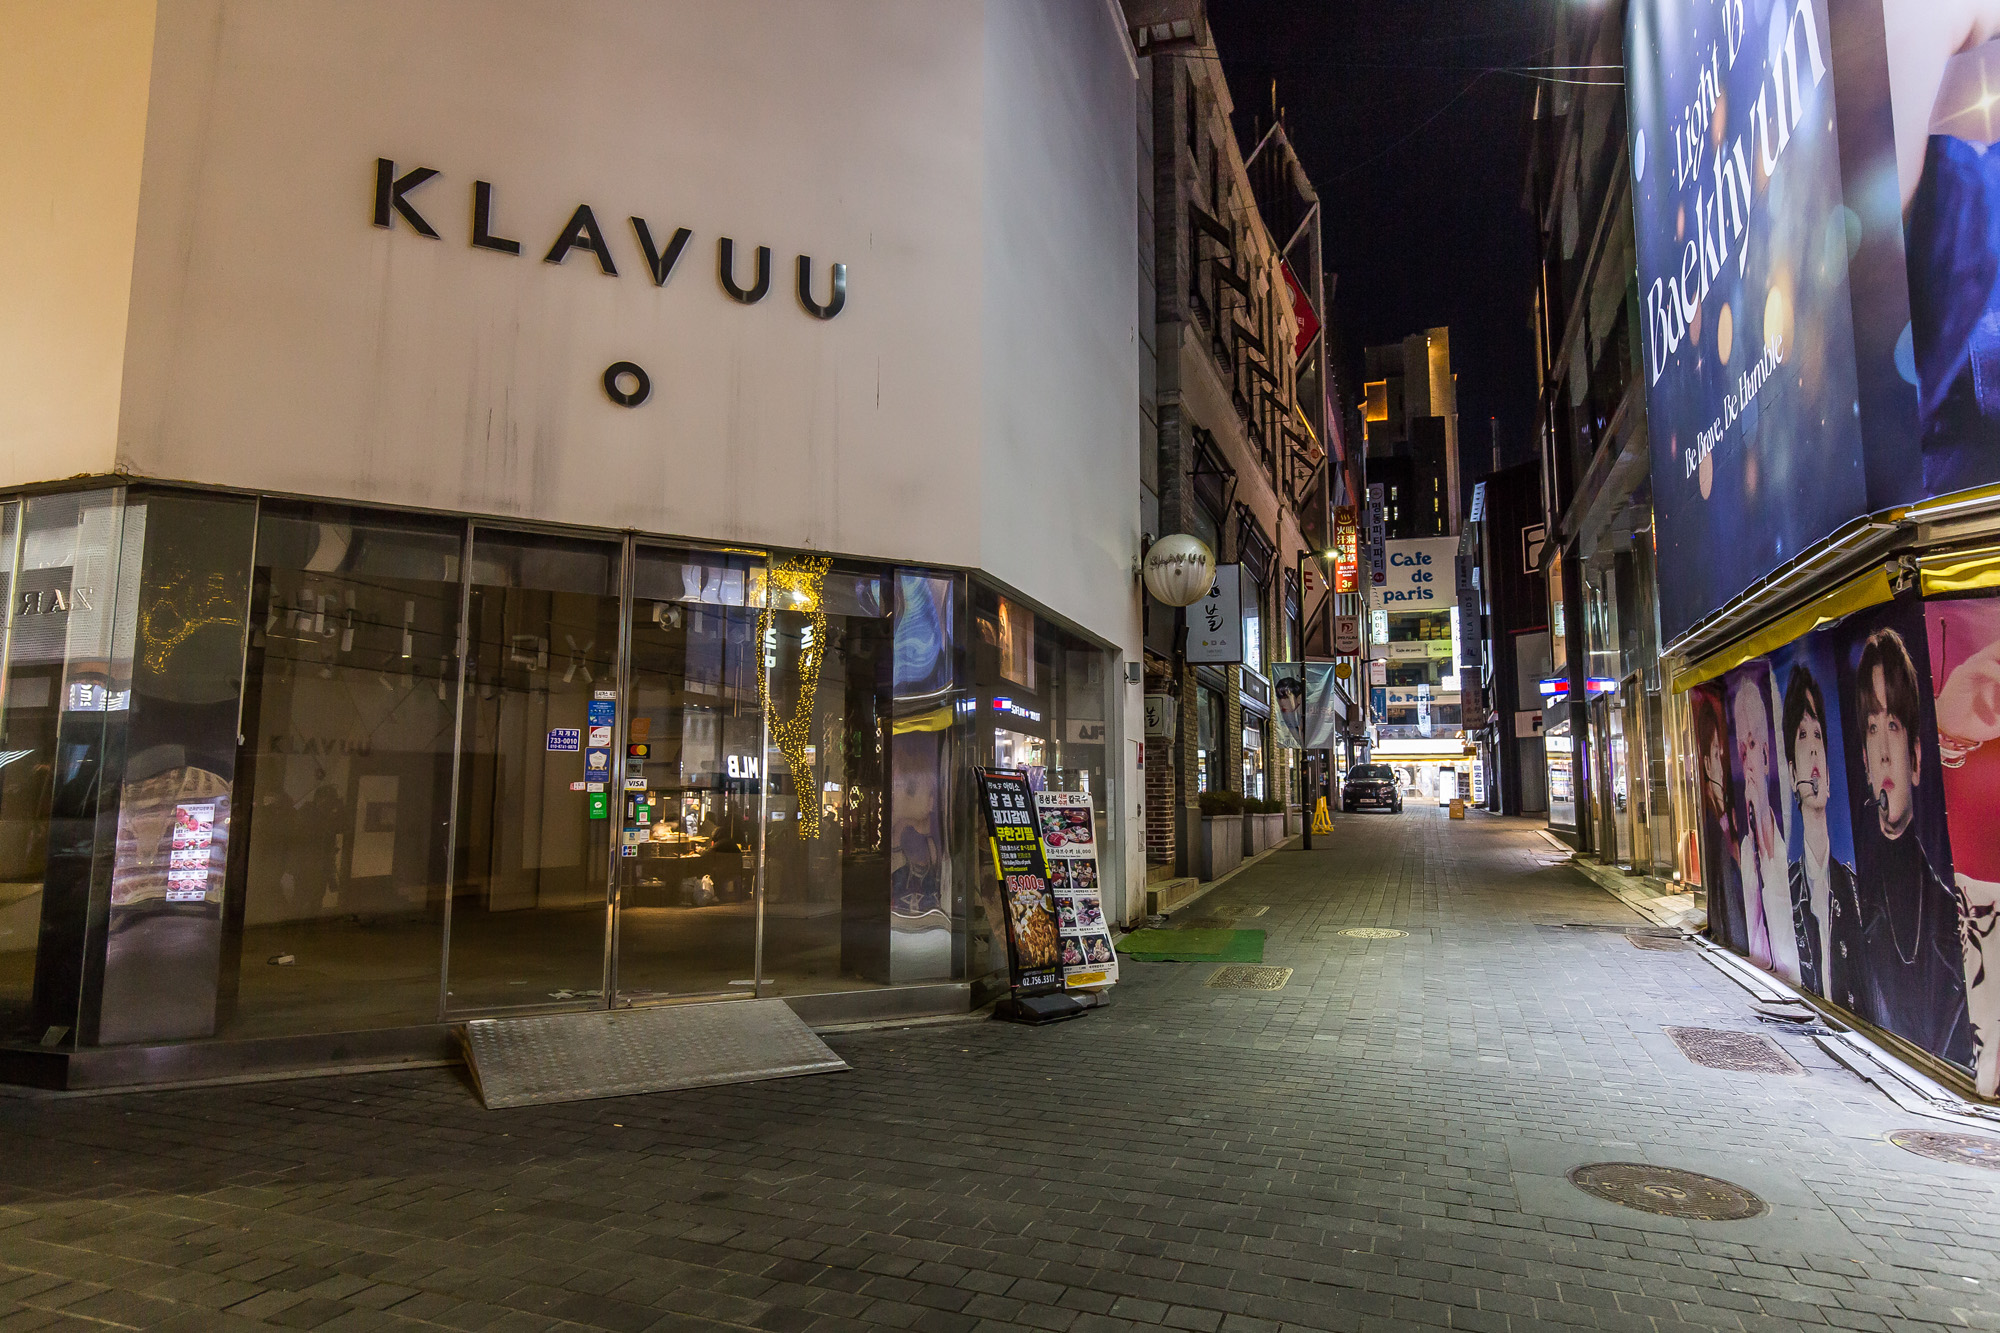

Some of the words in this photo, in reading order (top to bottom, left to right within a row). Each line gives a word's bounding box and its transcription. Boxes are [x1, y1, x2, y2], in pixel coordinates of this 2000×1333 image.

[1675, 39, 1722, 192] Light
[1647, 0, 1827, 388] Baekhyun
[373, 157, 847, 320] KLAVUU
[1684, 447, 1697, 479] Be
[1696, 417, 1724, 465] Brave,
[1723, 394, 1739, 431] Be
[1738, 333, 1784, 412] Humble
[1371, 502, 1384, 570] 명동파티파티
[1390, 551, 1432, 566] Cafe
[1411, 569, 1433, 583] de
[1341, 579, 1353, 589] 3F
[1383, 586, 1434, 604] paris
[1389, 694, 1402, 703] de
[1405, 693, 1435, 702] Paris
[550, 737, 578, 745] 733-0010
[628, 780, 645, 788] VISA
[992, 809, 1031, 825] 돼지갈비
[996, 826, 1035, 841] 무한리필
